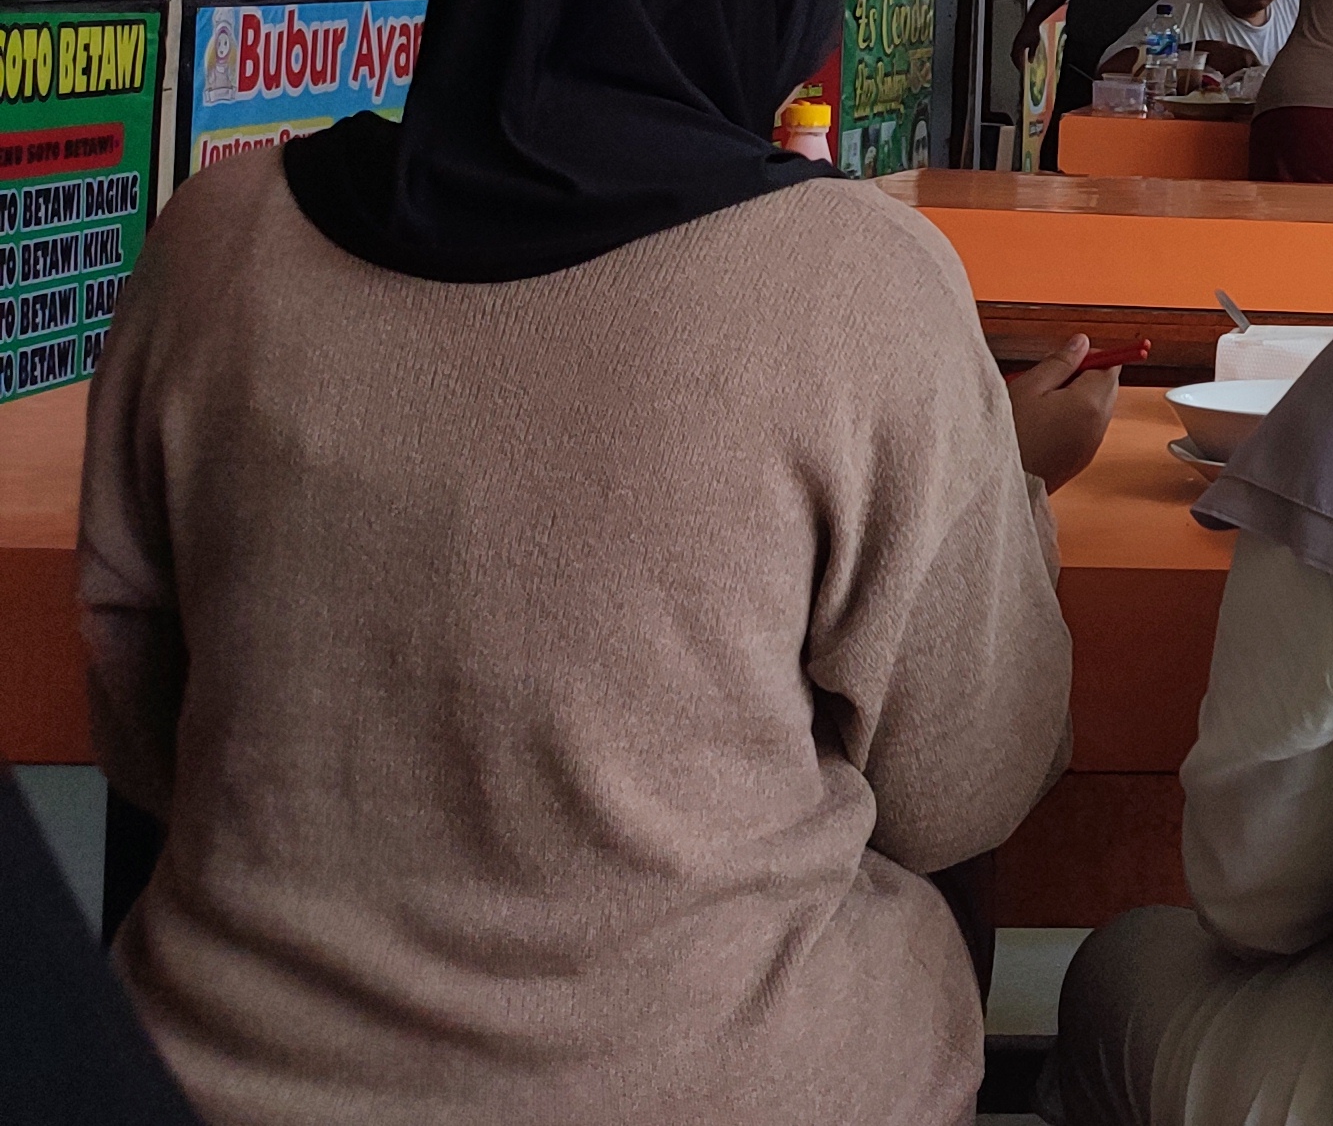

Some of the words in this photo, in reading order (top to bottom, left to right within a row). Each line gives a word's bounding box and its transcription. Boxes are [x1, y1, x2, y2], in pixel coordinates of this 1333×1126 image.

[58, 24, 146, 95] BETAWI
[237, 8, 348, 93] Bubur
[22, 182, 82, 229] BETAWI
[85, 174, 139, 218] DAGING
[21, 234, 79, 282] BETAWI
[82, 226, 122, 270] KIKIL
[19, 286, 77, 336] BETAWI
[85, 275, 130, 320] BAB
[17, 338, 76, 390] BETAWI
